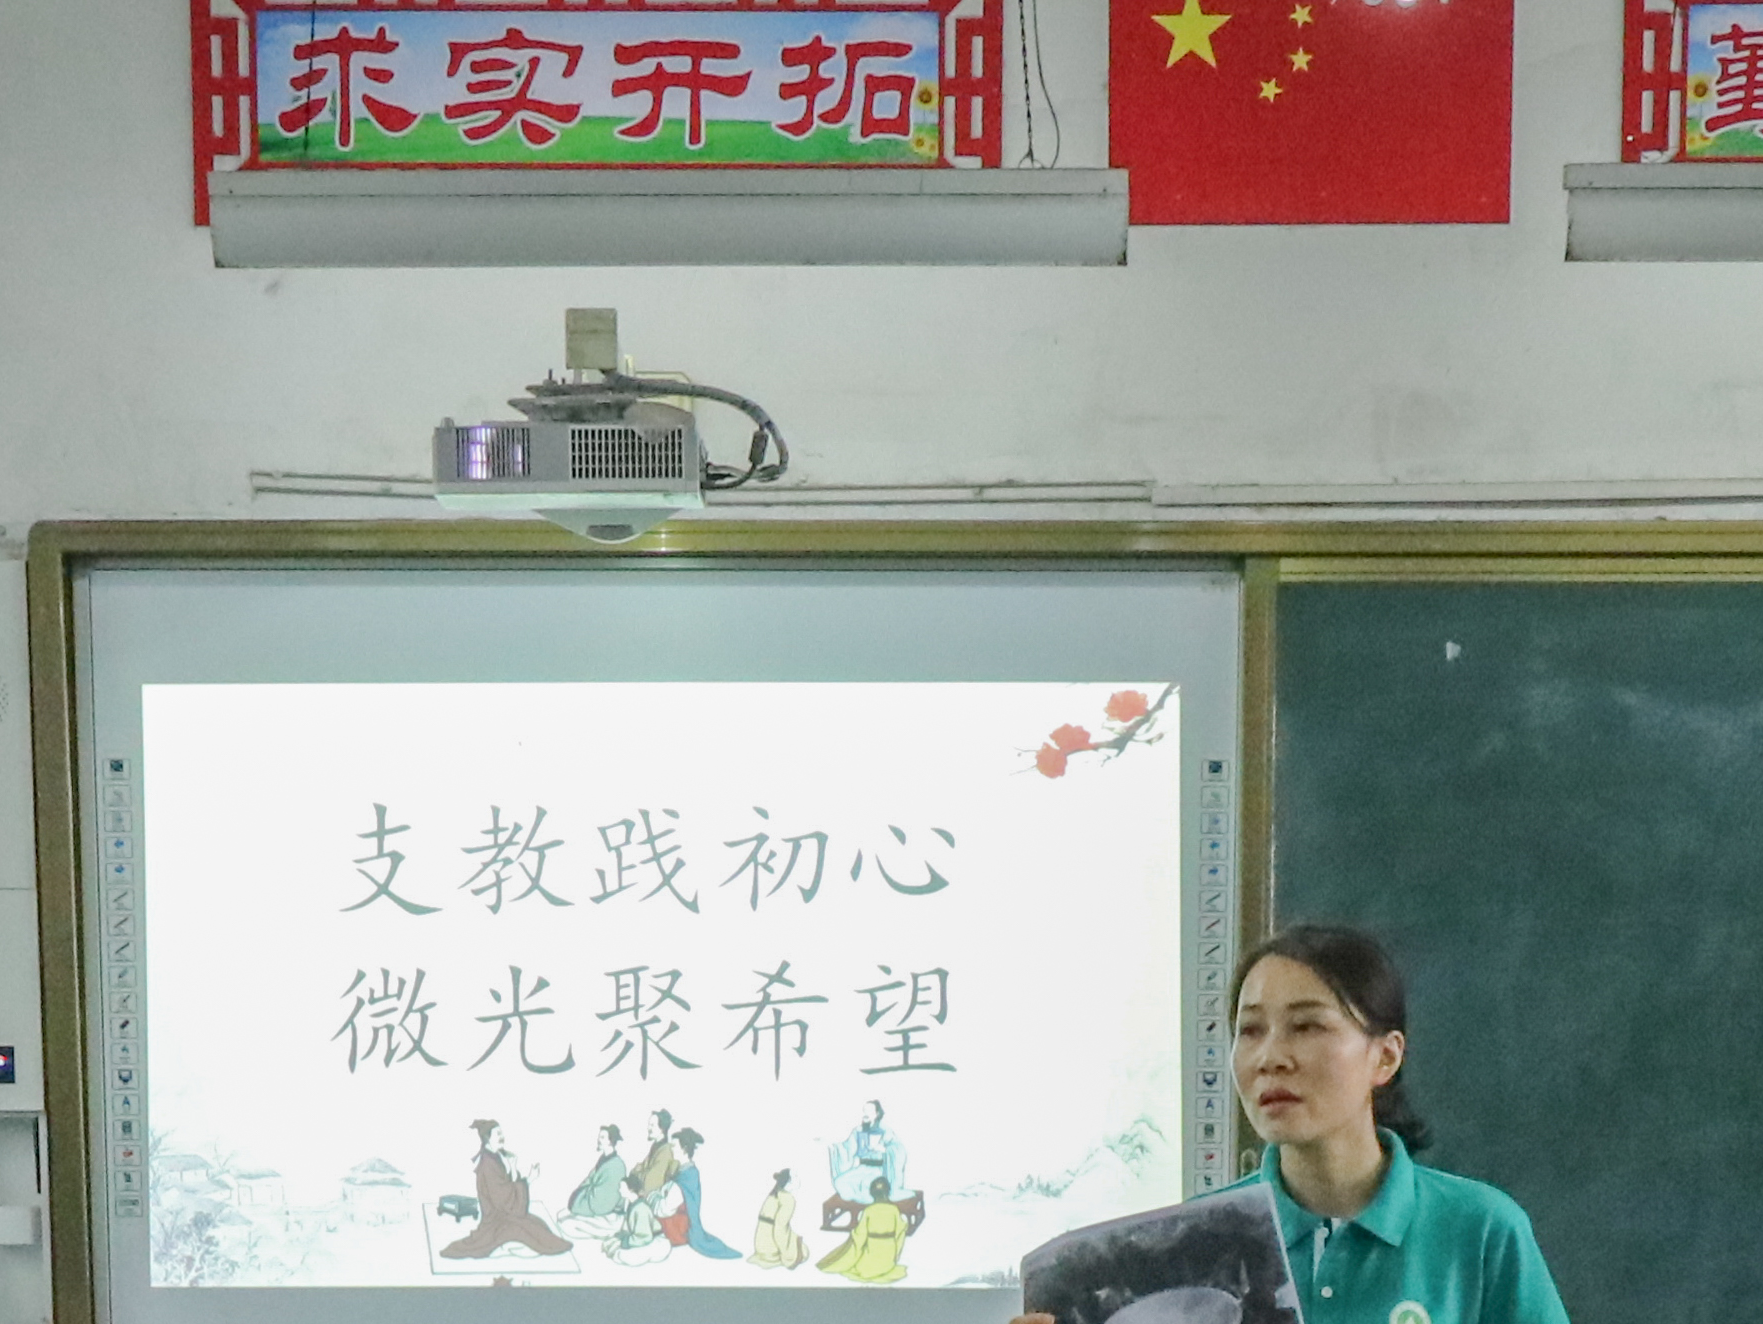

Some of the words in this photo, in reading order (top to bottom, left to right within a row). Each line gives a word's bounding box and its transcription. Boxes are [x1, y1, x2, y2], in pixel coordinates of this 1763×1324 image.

[277, 24, 917, 150] 求实开拓
[339, 801, 956, 916] 支教践初心
[331, 958, 958, 1082] 微光聚希望
